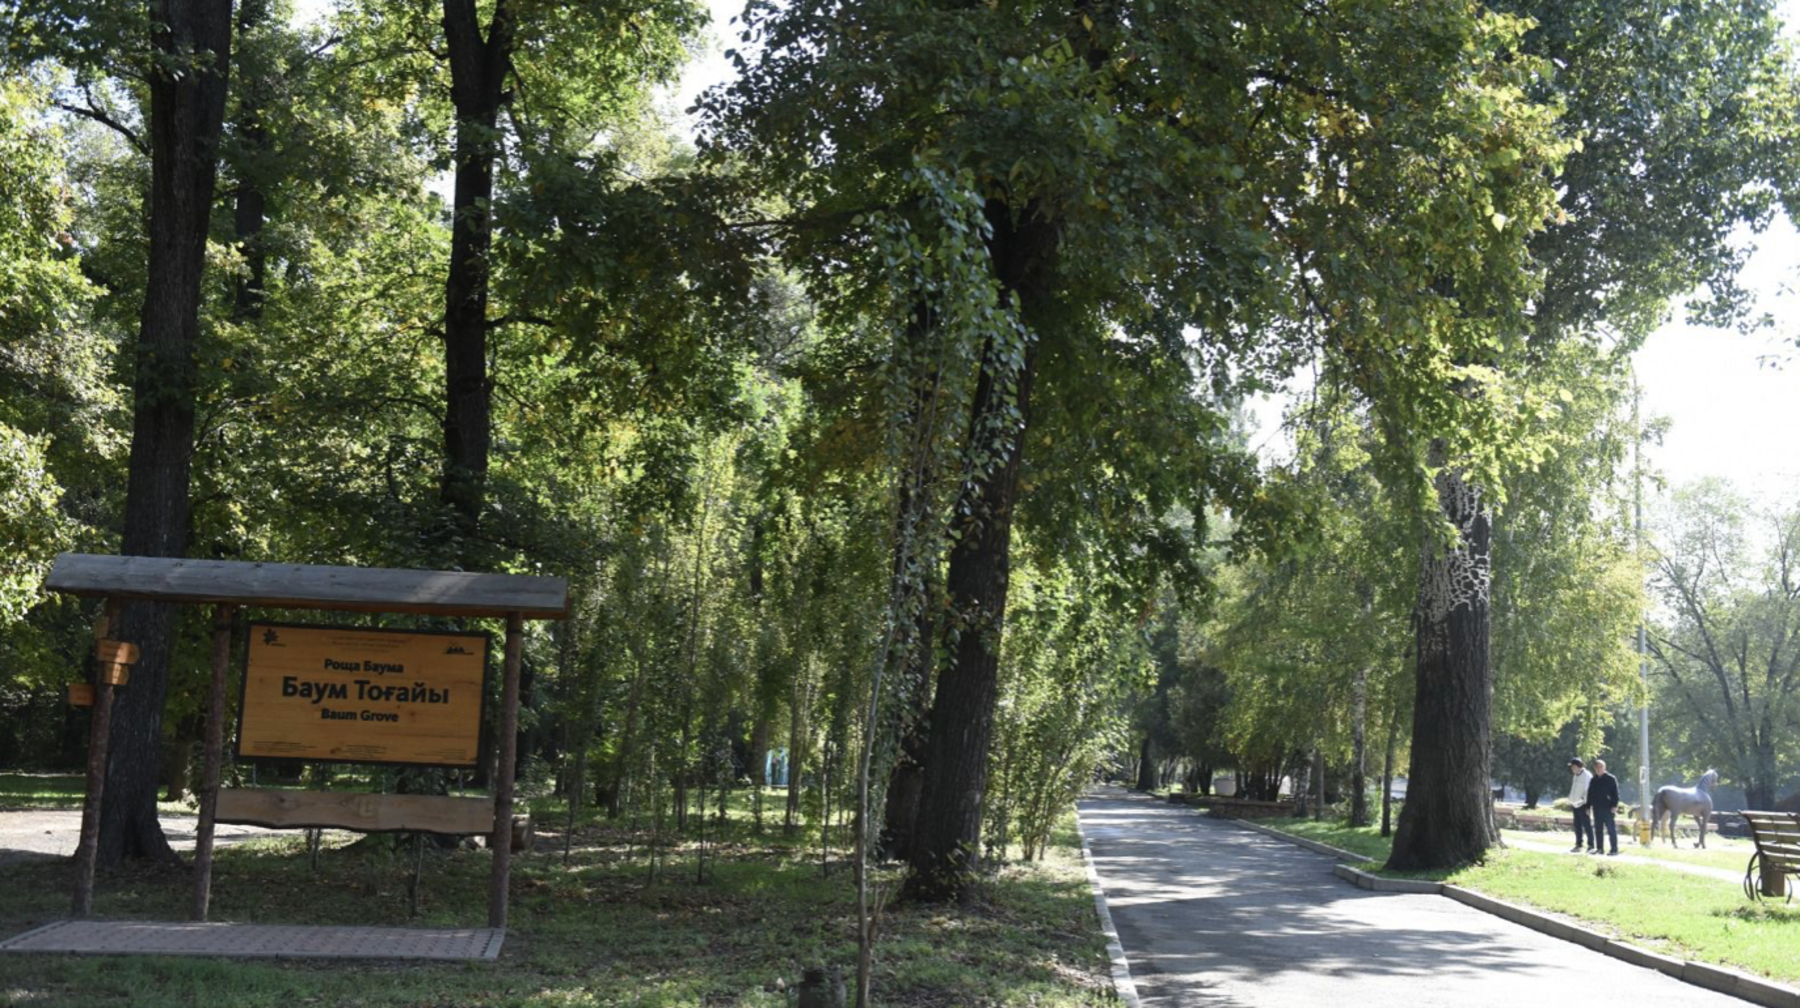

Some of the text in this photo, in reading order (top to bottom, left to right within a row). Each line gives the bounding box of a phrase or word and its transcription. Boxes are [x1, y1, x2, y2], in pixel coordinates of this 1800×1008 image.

[324, 658, 404, 675] Роща Баума
[282, 676, 449, 704] Баум Тоғайы
[321, 708, 399, 722] Baum Grove
